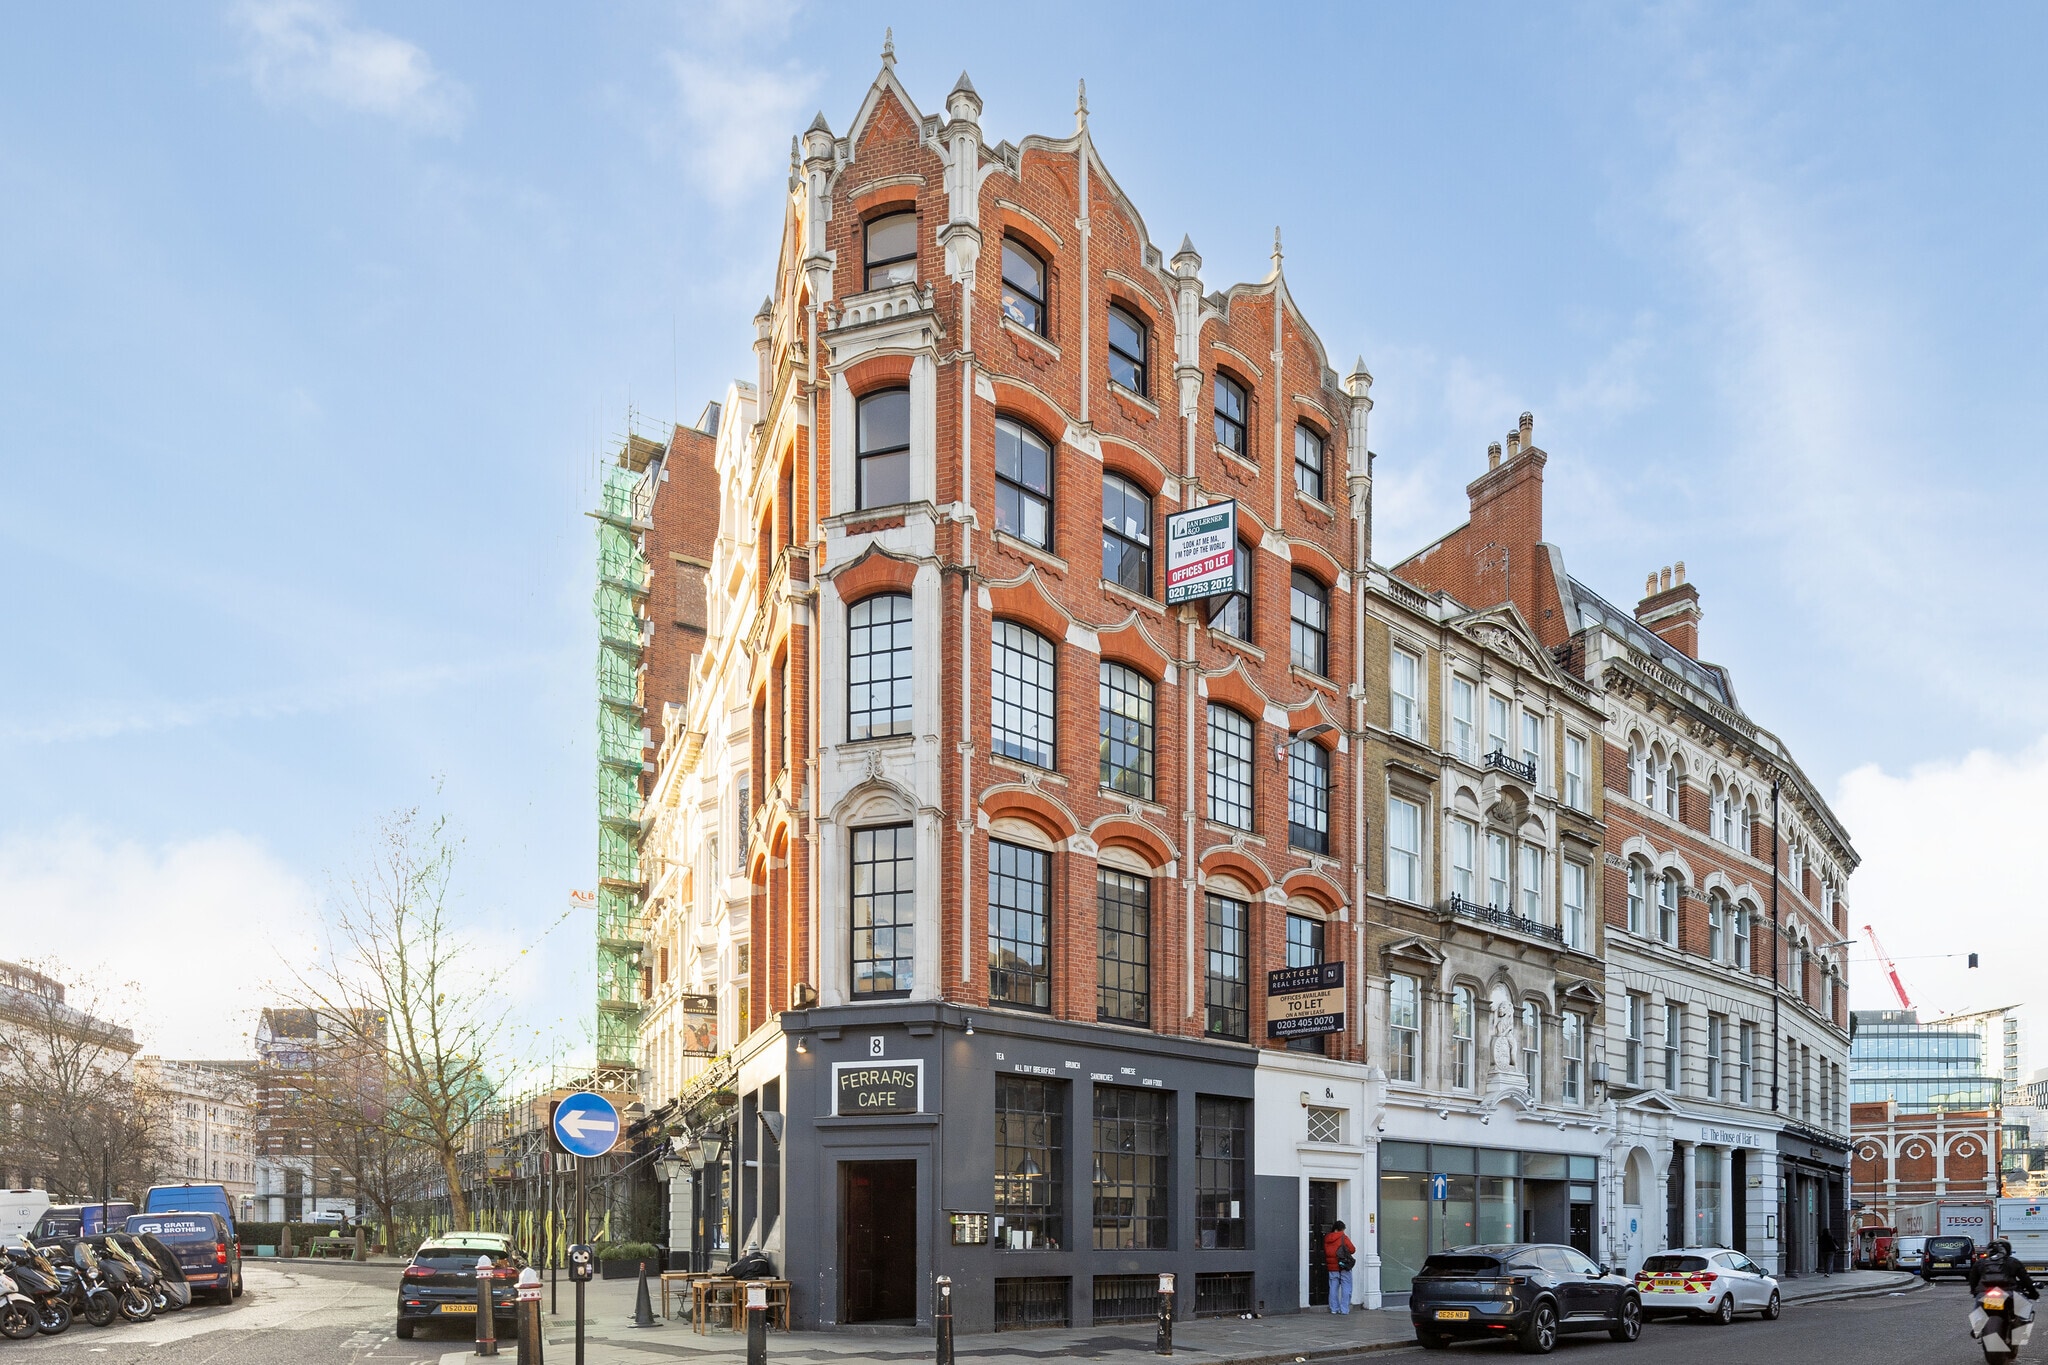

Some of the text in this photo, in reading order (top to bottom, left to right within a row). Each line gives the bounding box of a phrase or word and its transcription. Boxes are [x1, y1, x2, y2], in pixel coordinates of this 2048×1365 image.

[1187, 514, 1223, 529] IAN LERNER
[1196, 538, 1202, 547] AT
[1203, 536, 1209, 545] ME
[1184, 549, 1192, 557] TOP
[1193, 547, 1199, 555] OF
[1172, 554, 1230, 582] OFFICES TO LET
[1169, 587, 1185, 599] 020
[1187, 582, 1209, 595] 7253
[1211, 577, 1233, 590] 2012
[572, 890, 595, 900] ALB
[1272, 968, 1319, 981] NEXTGEN
[1272, 981, 1290, 989] REAL
[1292, 976, 1319, 986] ESTATE
[1280, 990, 1331, 1002] OFFICES AVAILABLE
[1288, 998, 1323, 1011] TO LET
[1310, 1008, 1325, 1016] LEASE
[1277, 1015, 1334, 1030] 0203 405 0070
[1275, 1024, 1335, 1036] nextgenrealestate.co.uk
[872, 1038, 881, 1053] 8
[995, 1052, 1004, 1060] TEA
[1014, 1064, 1056, 1075] ALL DAY BREAKFAST
[1065, 1060, 1080, 1069] BRUNCH
[1120, 1067, 1136, 1075] CHINESE
[840, 1070, 915, 1091] FERRARIS
[1152, 1079, 1162, 1087] FOOD
[858, 1091, 897, 1107] CAFE
[1710, 1129, 1752, 1144] The House of Hair
[1946, 1216, 1983, 1224] TESCO
